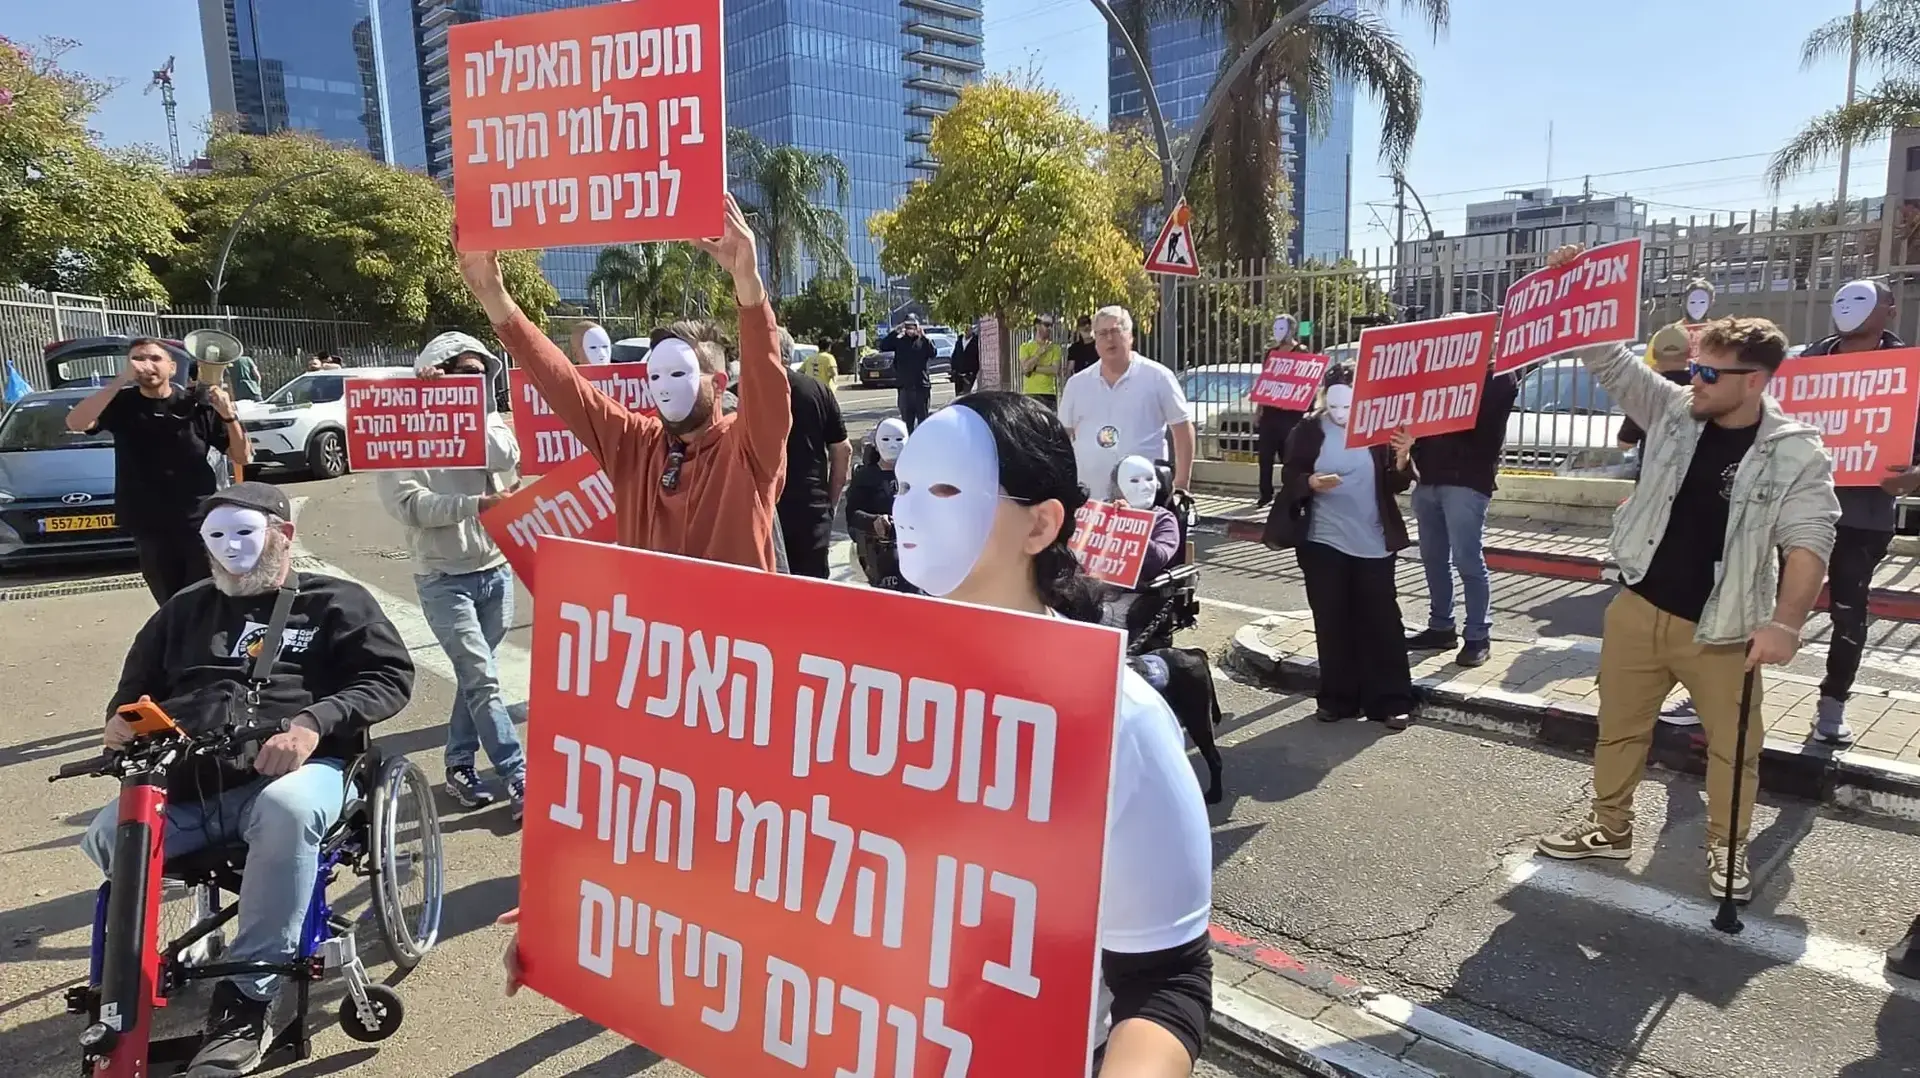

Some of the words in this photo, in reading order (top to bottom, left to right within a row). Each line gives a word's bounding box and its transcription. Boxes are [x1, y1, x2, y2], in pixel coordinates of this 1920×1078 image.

[465, 39, 581, 98] האפליה
[591, 23, 702, 93] תופסק
[467, 112, 550, 169] הקרב
[557, 95, 649, 155] הלומי
[658, 96, 705, 157] בין
[489, 177, 579, 228] פיזיים
[589, 160, 682, 222] לנכים
[1508, 278, 1554, 318] הלומי
[1555, 254, 1629, 301] אפליית
[1502, 314, 1554, 358] הורגת
[1557, 298, 1618, 338] הקרב
[1265, 357, 1294, 377] הקרב
[1294, 358, 1324, 379] הלומי
[1367, 331, 1483, 382] פוסטראומה
[350, 385, 416, 408] האפלייה
[421, 386, 478, 409] תופסק
[1292, 382, 1313, 402] לא
[1417, 382, 1477, 424] הורגת
[1791, 367, 1908, 402] בפקודתכם
[353, 414, 398, 437] הקרב
[401, 409, 448, 433] הלומי
[453, 412, 477, 434] בין
[1353, 391, 1416, 439] בשקט
[1854, 406, 1892, 434] כדי
[366, 439, 414, 460] פיזיים
[418, 435, 466, 459] לנכים
[535, 430, 588, 463] ורגת
[1824, 440, 1878, 472] לחיו
[506, 490, 593, 553] הלומי
[1121, 540, 1140, 557] בין
[557, 594, 774, 746] האפליה
[792, 653, 1057, 823] תופסק
[549, 734, 696, 871] הקרב
[716, 787, 906, 949] הלומי
[928, 854, 1041, 999] בין
[577, 879, 743, 1032] פיזיים
[763, 955, 973, 1078] לנכים
